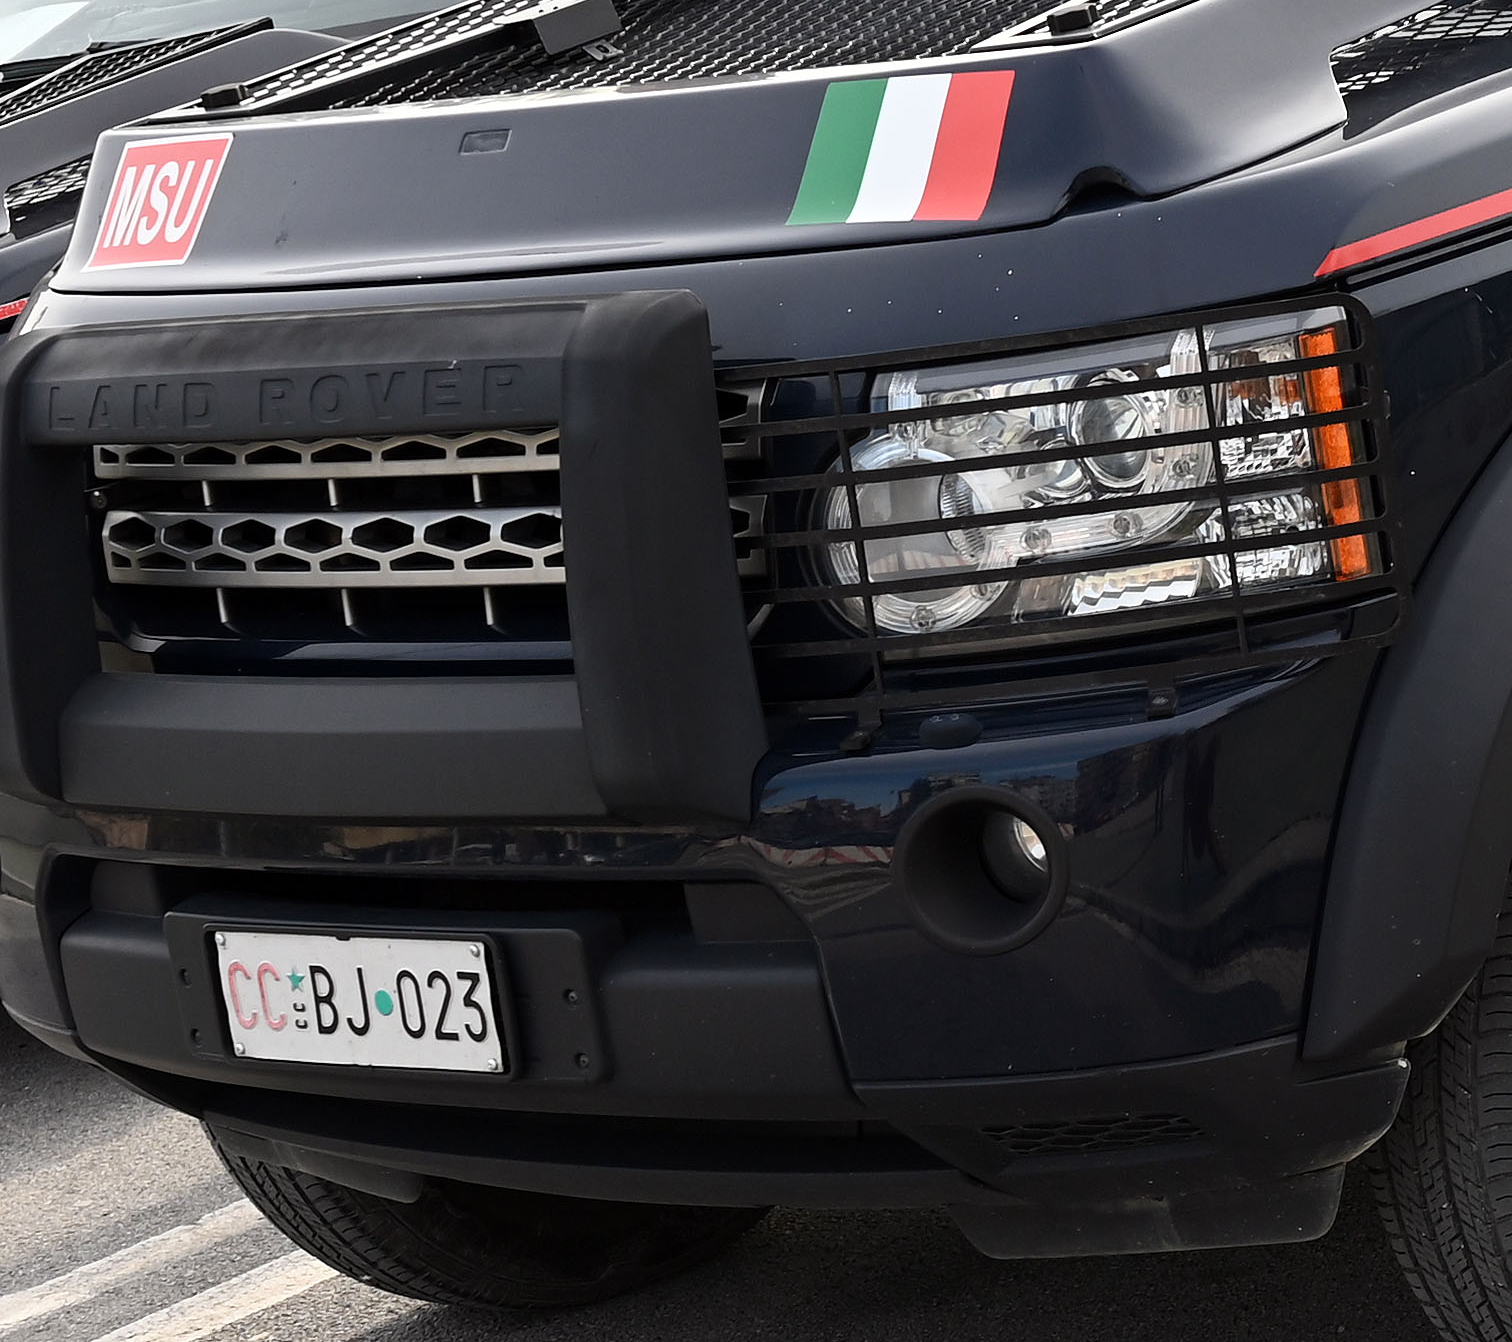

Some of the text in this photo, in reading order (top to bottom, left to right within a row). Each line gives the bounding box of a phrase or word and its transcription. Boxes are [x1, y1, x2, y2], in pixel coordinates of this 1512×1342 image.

[102, 158, 215, 250] MSU
[48, 363, 526, 432] LAND ROVER
[227, 961, 488, 1043] CC BJ 023
